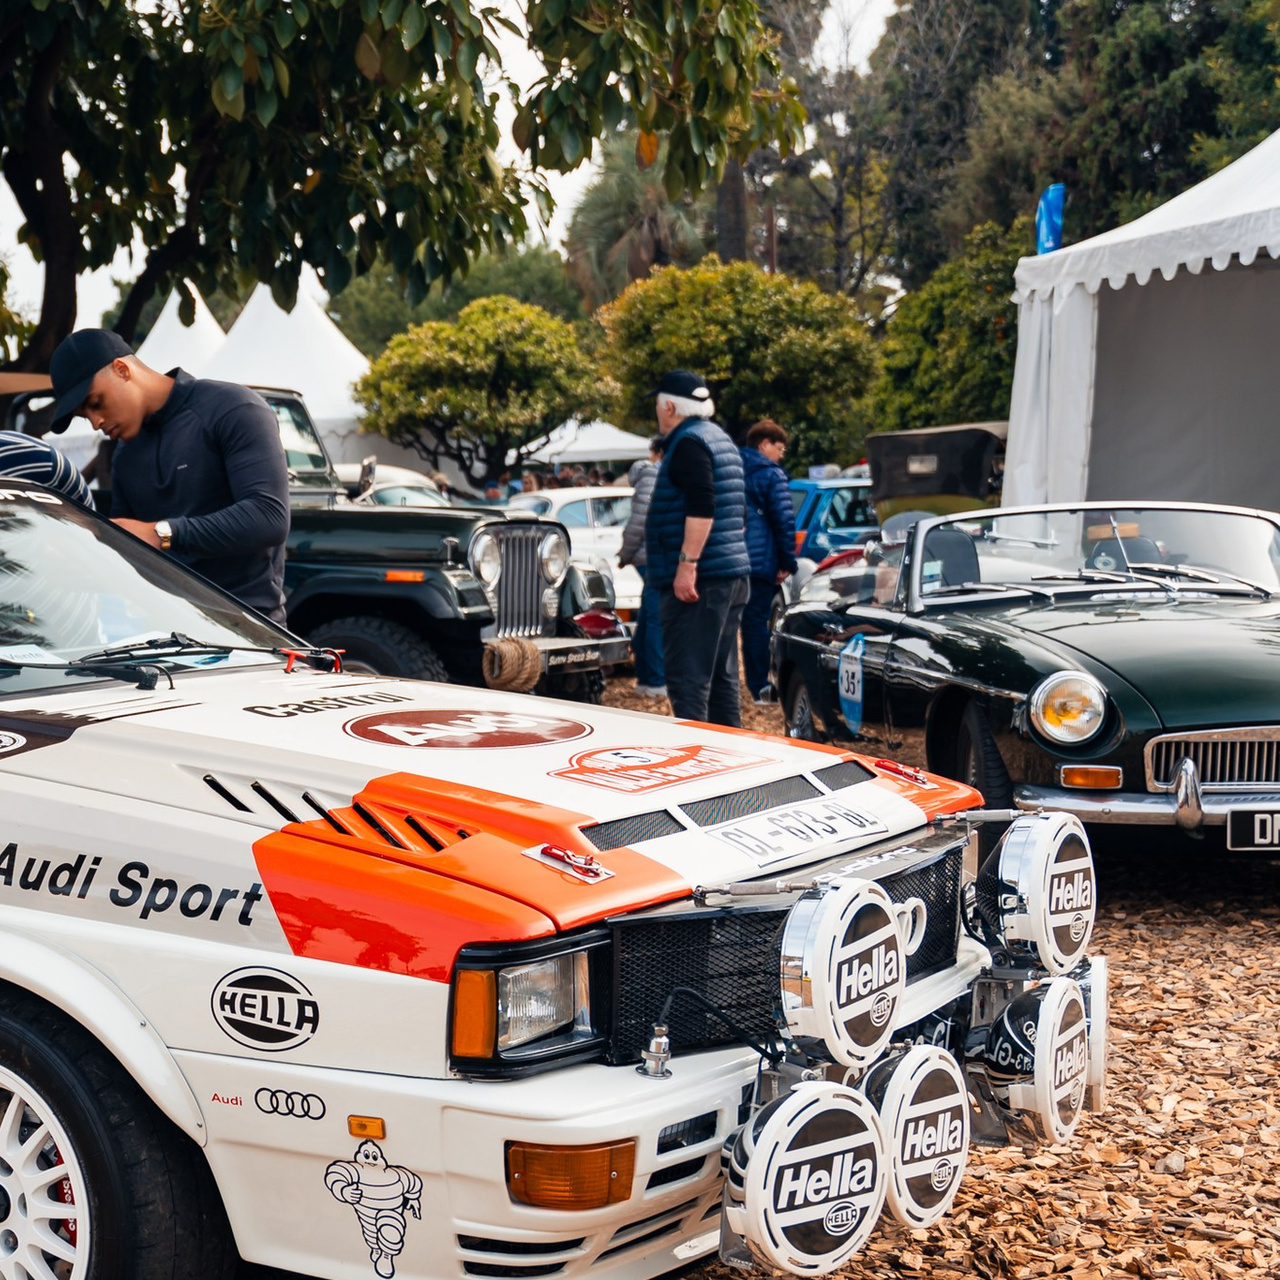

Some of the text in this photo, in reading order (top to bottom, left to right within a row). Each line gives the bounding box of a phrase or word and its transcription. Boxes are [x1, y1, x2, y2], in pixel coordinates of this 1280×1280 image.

[844, 669, 856, 696] 35
[242, 691, 416, 718] Castrol
[109, 861, 263, 926] Sport
[1051, 872, 1092, 912] Hella
[839, 944, 898, 1005] Hella
[219, 990, 320, 1034] HELLA
[872, 997, 891, 1016] HELLA
[1054, 1036, 1085, 1087] Hella
[211, 1092, 243, 1107] Audi
[903, 1111, 963, 1161] Hella
[776, 1151, 875, 1210] Hella
[934, 1165, 953, 1180] HELLA
[827, 1207, 858, 1225] HELLA
